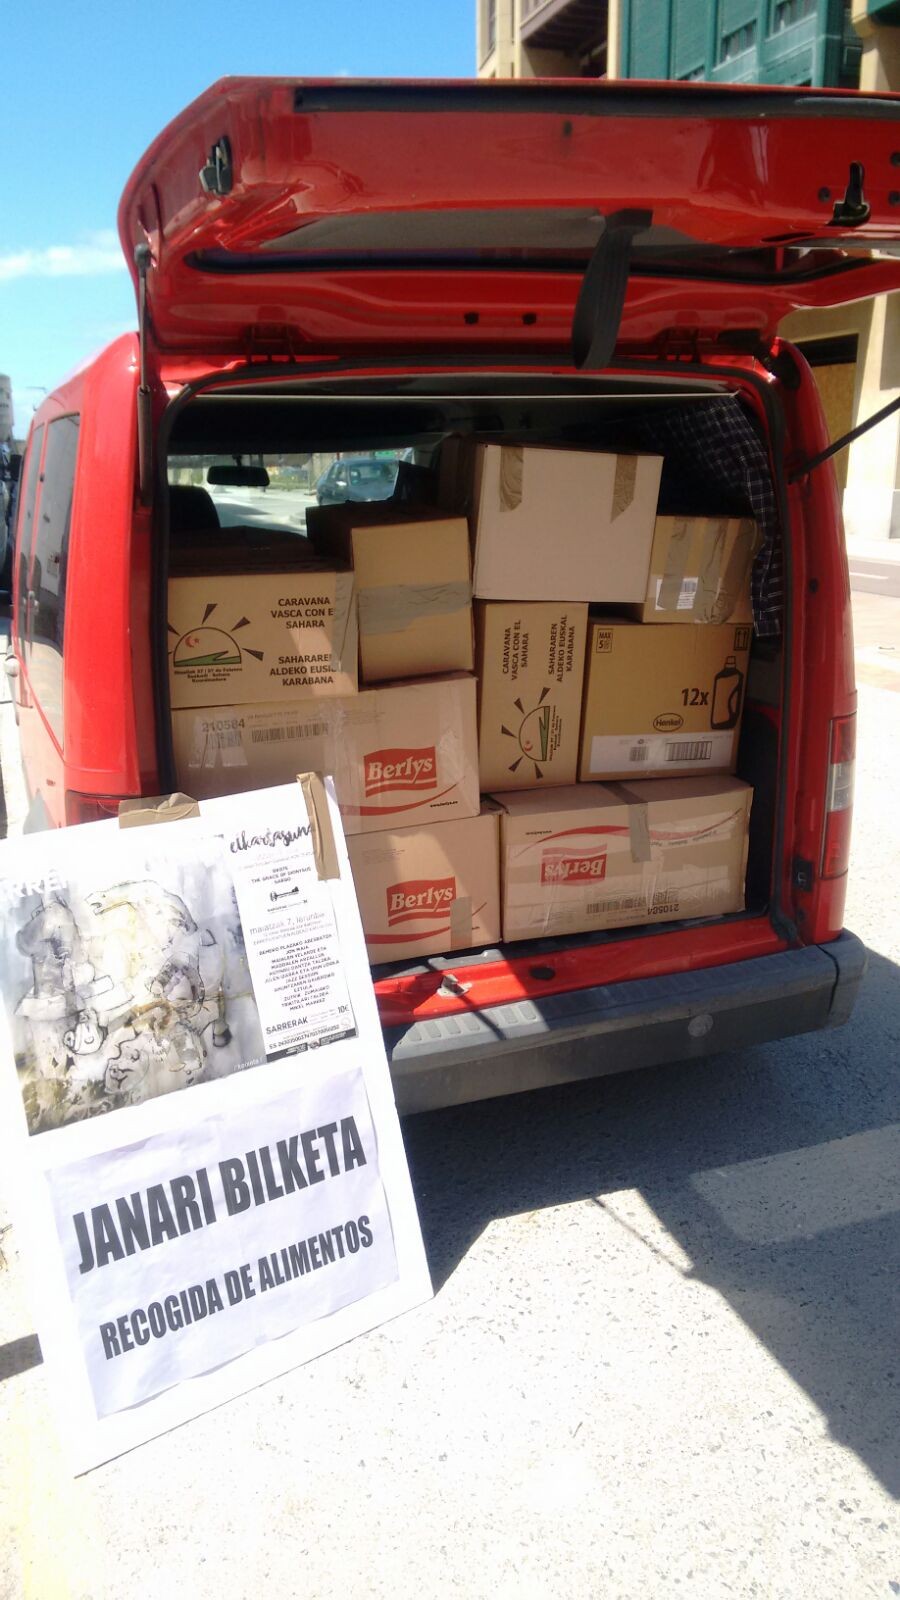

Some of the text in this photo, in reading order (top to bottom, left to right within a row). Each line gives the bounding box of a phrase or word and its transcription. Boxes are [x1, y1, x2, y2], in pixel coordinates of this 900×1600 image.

[271, 608, 336, 618] VASCA CON E
[278, 597, 330, 606] CARAVANA
[286, 620, 325, 629] SAHARA
[599, 631, 611, 639] MAX
[502, 627, 511, 674] CARAVANA
[511, 620, 521, 681] VASCA CON EL
[520, 633, 529, 668] SAHARA
[548, 623, 557, 675] SAHARAREN
[557, 615, 568, 683] ALDEKO EUSKAL
[566, 626, 575, 672] KARABANA
[270, 666, 307, 676] ALDEKO
[282, 676, 334, 686] KARABANA
[681, 687, 709, 707] 12x
[202, 718, 245, 733] 210584
[655, 719, 681, 727] Henkel
[367, 755, 433, 783] Berlys
[544, 855, 605, 879] Berlys
[390, 886, 453, 912] Berlys
[264, 1016, 308, 1034] SARRERAK
[337, 1004, 349, 1013] 10€
[72, 1115, 367, 1274] JANARI BILKETA
[100, 1215, 374, 1360] RECOGIDA DE ALIMENTOS
